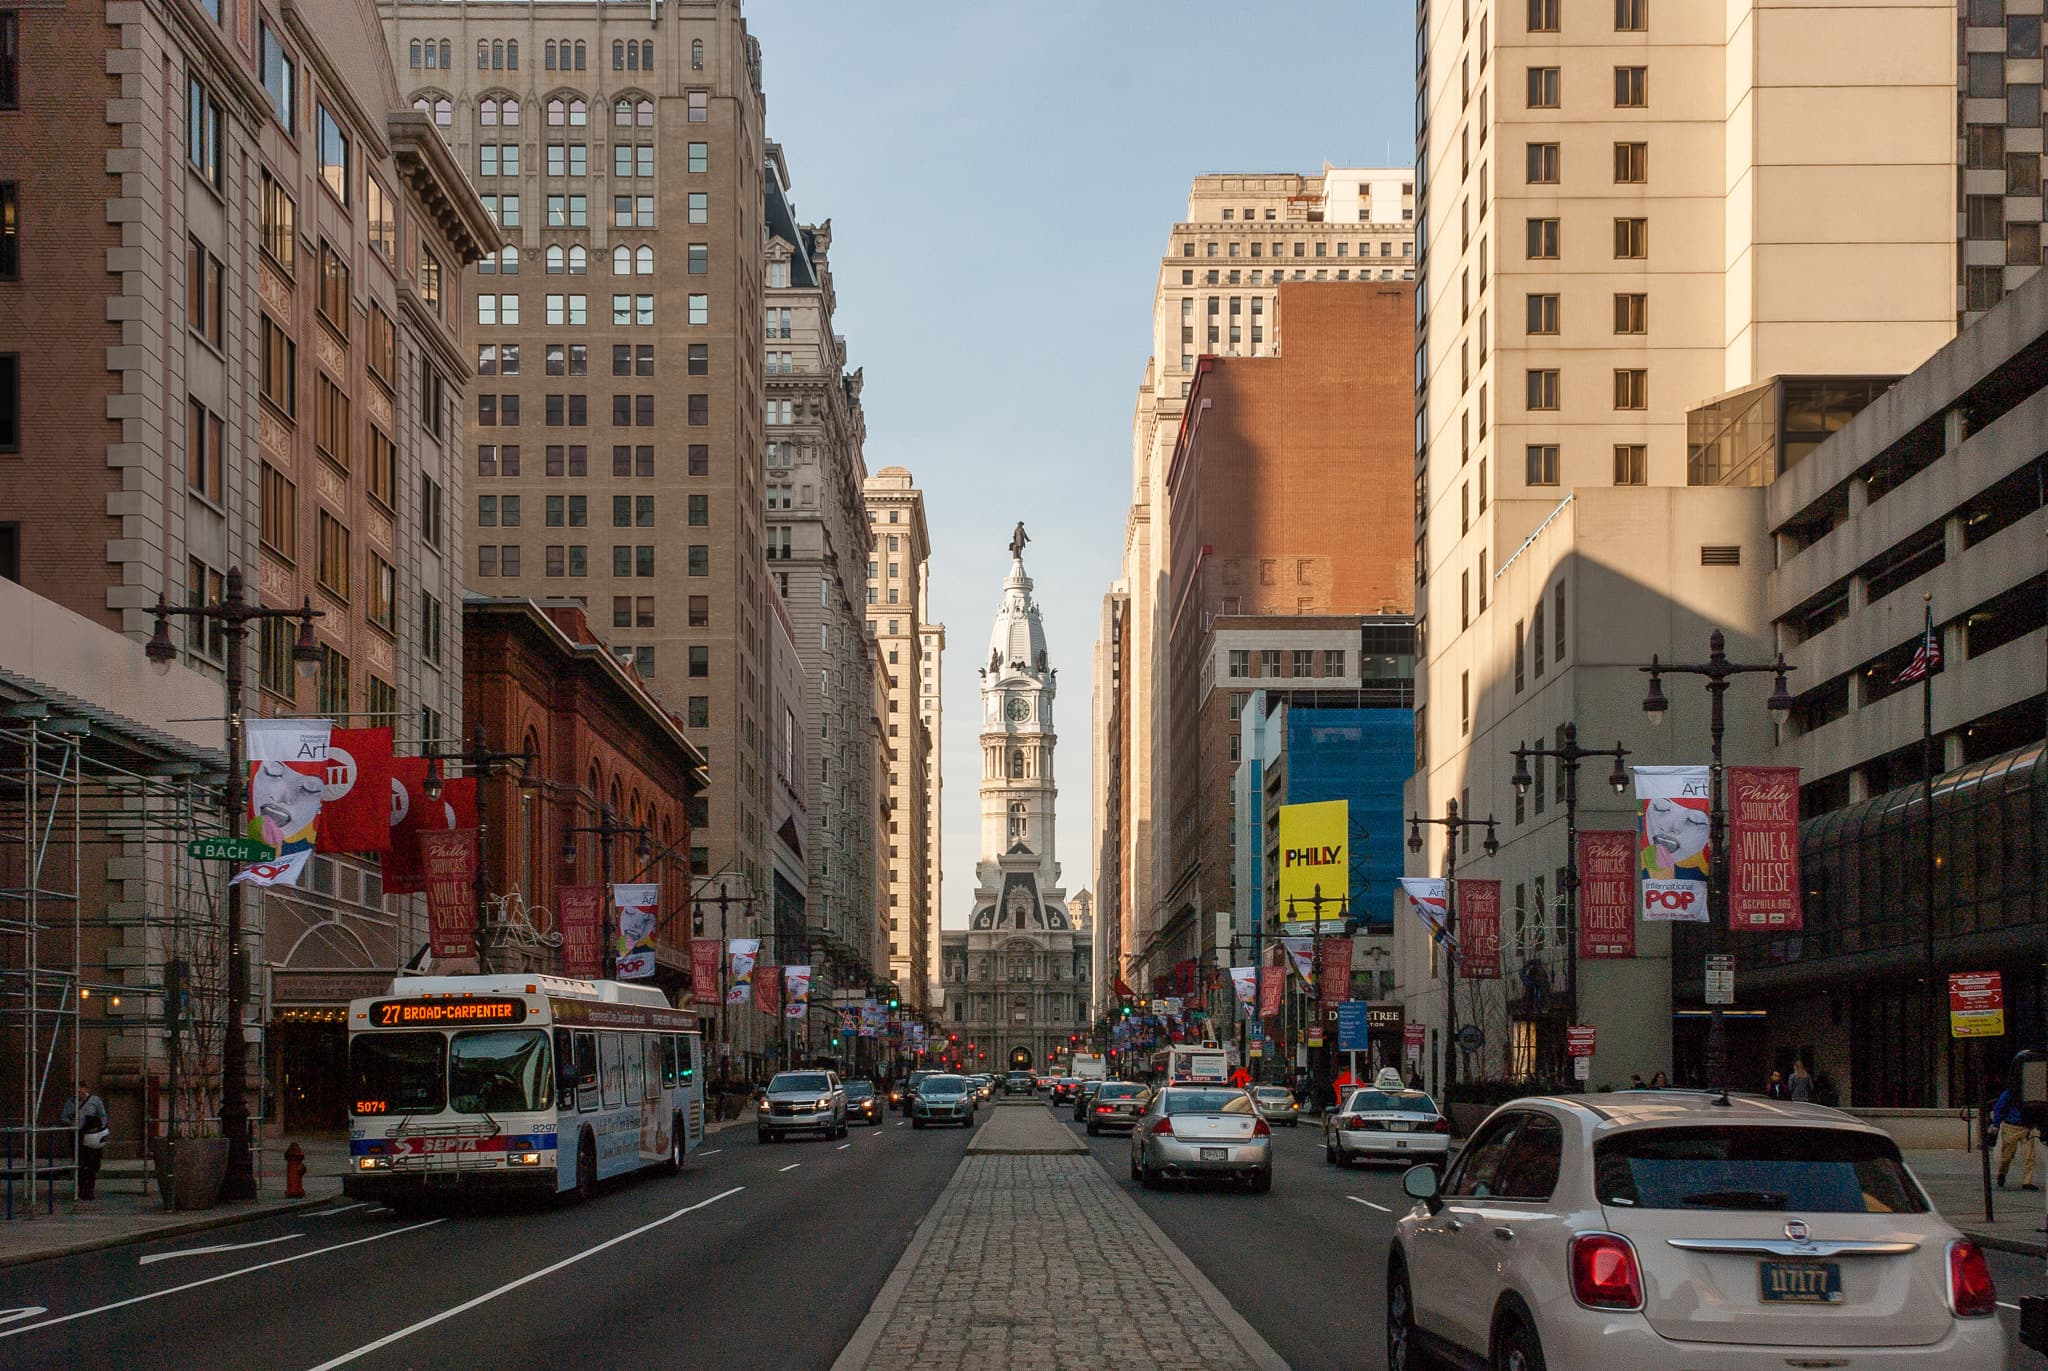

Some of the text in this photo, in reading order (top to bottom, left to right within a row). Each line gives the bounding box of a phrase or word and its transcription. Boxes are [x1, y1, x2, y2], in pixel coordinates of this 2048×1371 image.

[296, 742, 329, 759] Art
[1682, 783, 1709, 797] Art
[1739, 784, 1792, 806] Philly
[1741, 802, 1788, 821] SHOWCASE
[205, 845, 273, 861] BACH PL
[428, 845, 471, 858] Philly
[1588, 844, 1630, 858] Philly
[1742, 831, 1790, 861] WINE &
[1285, 845, 1342, 868] PHILLY.
[1589, 858, 1626, 873] SHOWCASE
[1742, 862, 1791, 892] CHEESE
[1428, 888, 1444, 897] Art
[1589, 881, 1627, 905] WINE &
[1645, 881, 1694, 891] International
[1645, 889, 1696, 911] POP
[1590, 905, 1627, 929] CHEESE
[617, 960, 645, 974] POP
[382, 1003, 513, 1024] 27 BROAD-CARPENTER
[356, 1100, 387, 1113] 5074
[532, 1123, 557, 1134] 8297
[422, 1137, 477, 1152] SEPTA
